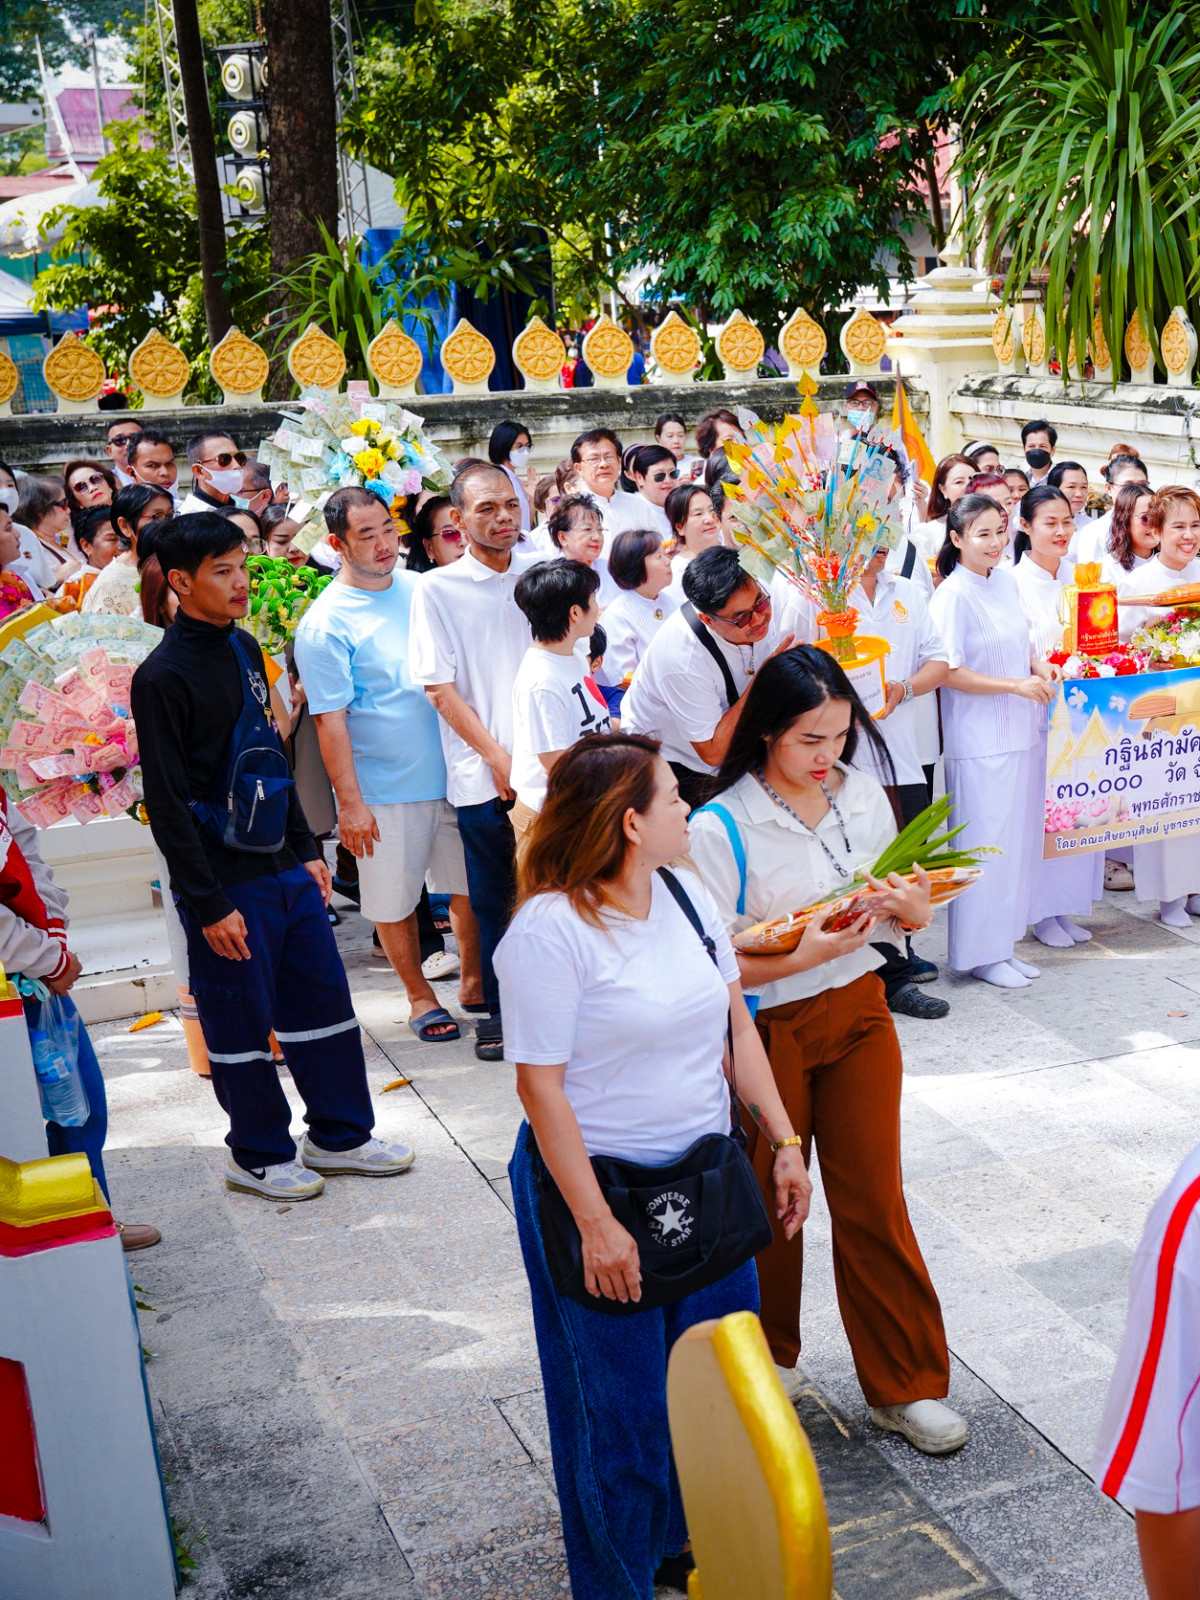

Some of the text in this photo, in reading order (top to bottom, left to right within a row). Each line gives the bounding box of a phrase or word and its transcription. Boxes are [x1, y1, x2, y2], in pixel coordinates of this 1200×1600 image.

[571, 682, 596, 727] I
[1056, 774, 1143, 799] ๓๐,๐๐๐
[1165, 760, 1187, 783] วัด
[1056, 837, 1077, 849] โดย
[645, 1191, 691, 1215] CONVERSE
[651, 1227, 693, 1247] ALL STAR
